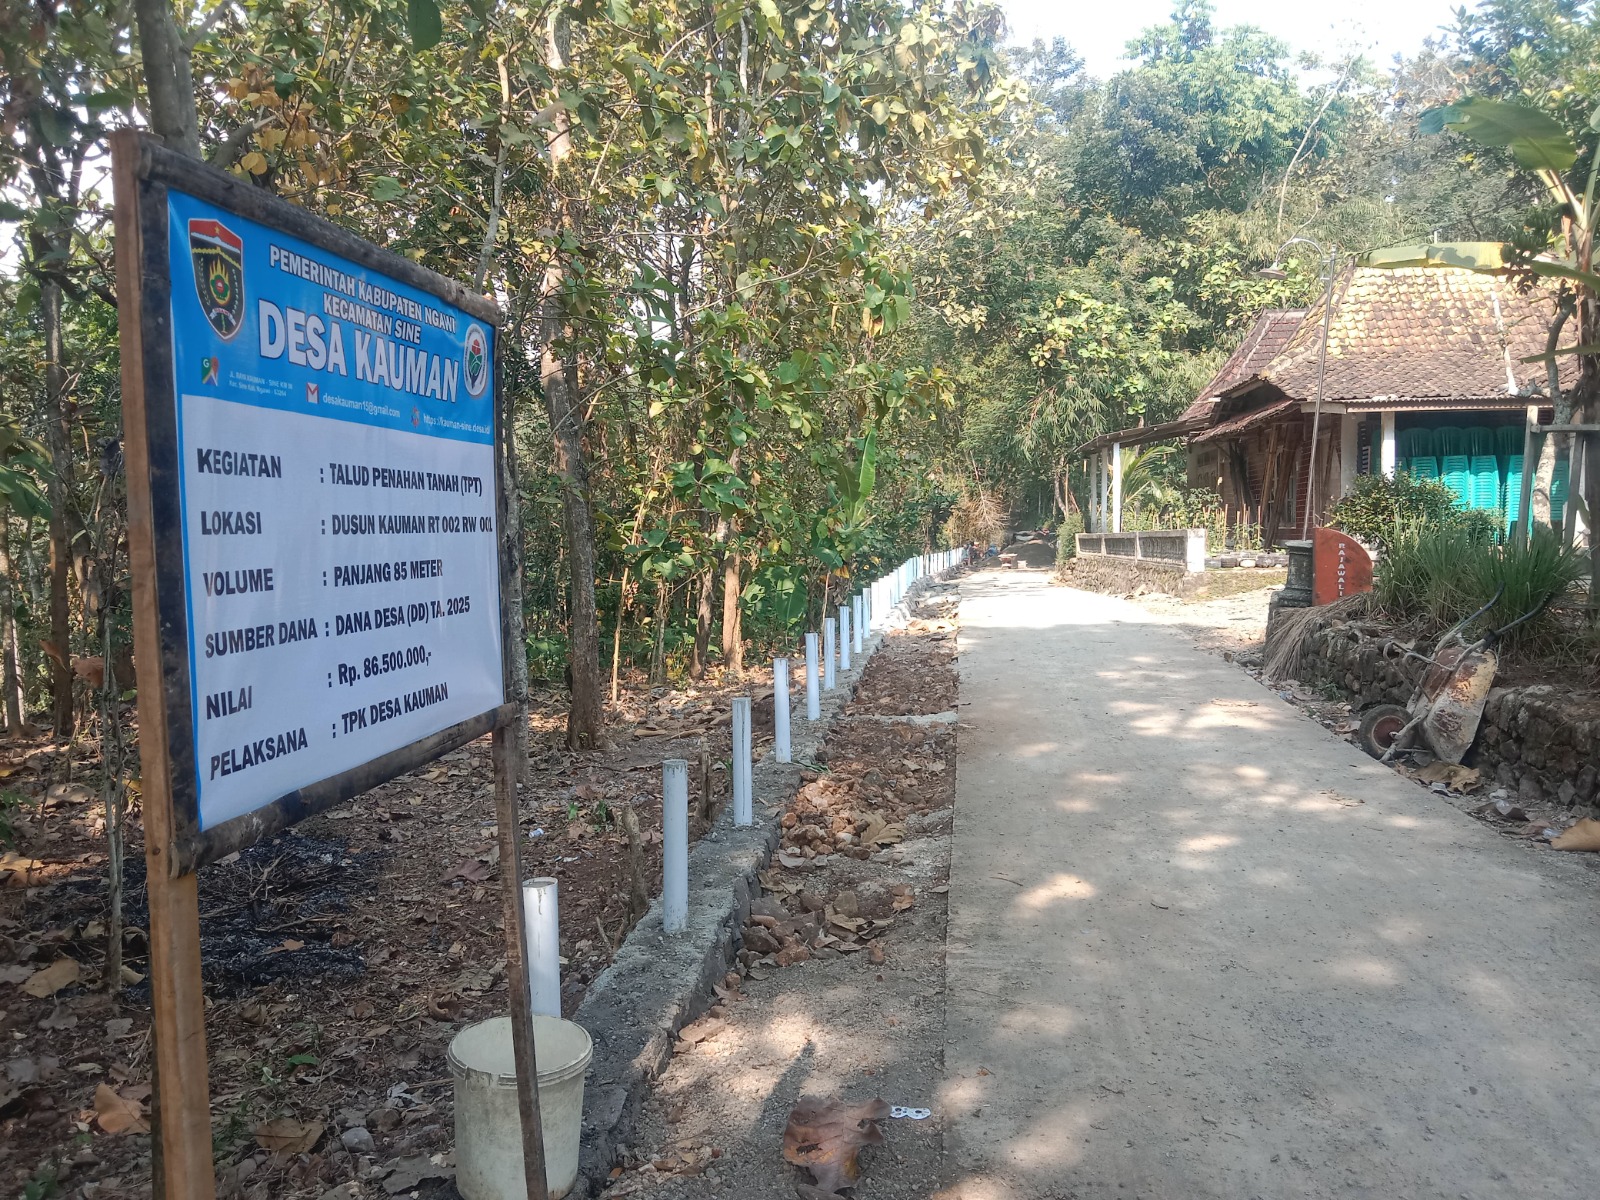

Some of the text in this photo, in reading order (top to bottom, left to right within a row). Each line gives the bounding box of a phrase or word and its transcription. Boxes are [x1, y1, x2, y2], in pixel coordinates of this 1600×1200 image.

[270, 243, 457, 334] PEMERINTAH KABUPATEN NGAWI
[323, 292, 422, 345] KECAMATAN SINE
[258, 298, 348, 378] DESA
[353, 328, 460, 404] KAUMAN
[322, 392, 401, 418] desakauman15@gmail.com
[196, 447, 283, 480] KEGIATAN
[329, 462, 371, 487] TALUD
[371, 466, 426, 491] PENAHAN
[425, 472, 460, 493] TANAH
[459, 474, 484, 498] (TPT)
[200, 510, 263, 536] LOKASI
[331, 513, 376, 536] DUSUN
[378, 514, 426, 535] KAUMAN
[426, 515, 441, 534] RT
[441, 515, 461, 534] 002
[461, 516, 477, 533] RW
[479, 516, 493, 533] 001
[202, 567, 275, 598] VOLUME
[333, 562, 392, 588] PANJANG
[393, 561, 408, 581] 85
[409, 558, 444, 580] METER
[1337, 543, 1346, 597] RAJAWALI
[204, 623, 276, 660] SUMBER
[277, 617, 319, 646] DANA
[335, 610, 373, 637] DANA
[374, 605, 406, 630] DESA
[406, 602, 430, 628] (DD)
[430, 600, 446, 620] TA.
[446, 595, 471, 617] 2025
[205, 685, 253, 721] NILAI
[337, 663, 361, 687] Rp.
[363, 644, 432, 679] 86.500.000,-
[209, 726, 309, 781] PELAKSANA
[341, 707, 368, 735] TPK
[369, 697, 401, 726] DESA
[403, 681, 450, 715] KAUMAN
